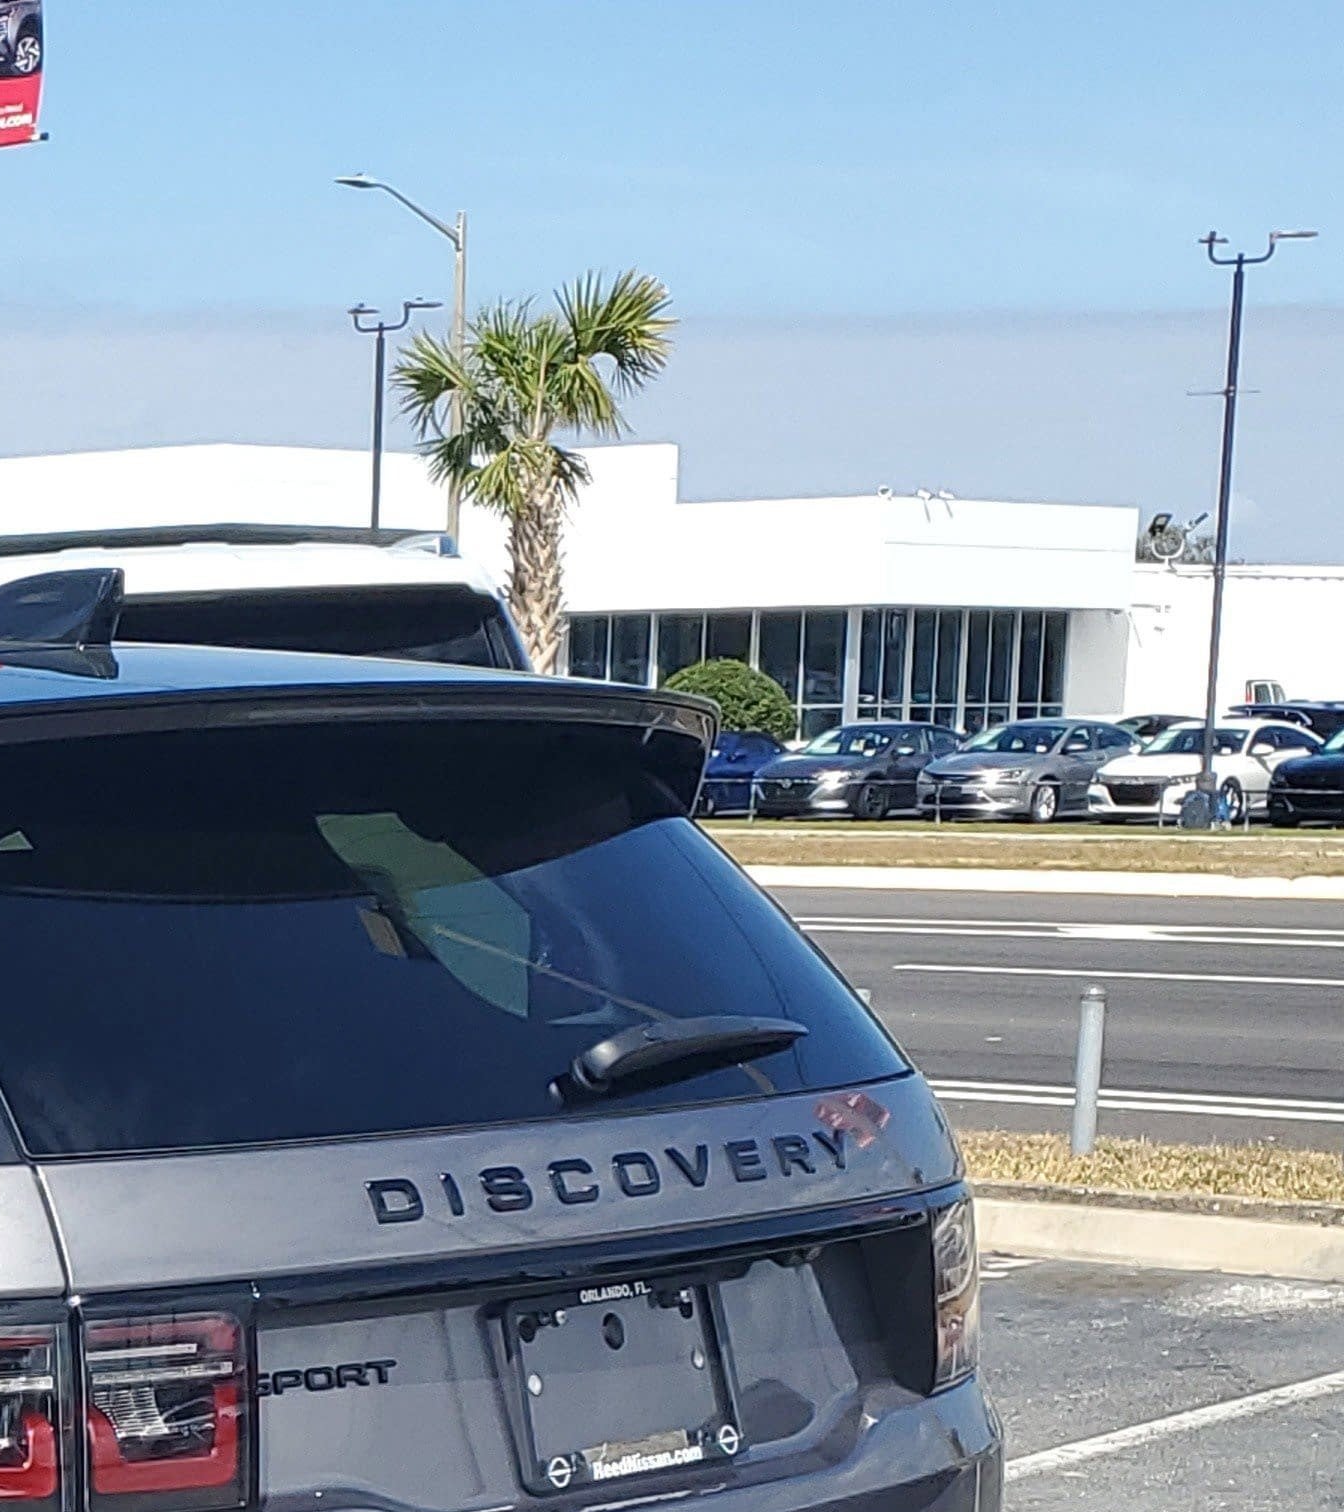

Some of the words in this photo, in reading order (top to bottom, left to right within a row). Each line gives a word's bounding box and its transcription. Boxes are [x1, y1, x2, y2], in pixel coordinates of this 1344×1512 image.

[365, 1130, 850, 1224] DISCOVERY
[579, 1283, 633, 1303] ORLANDO,
[257, 1358, 398, 1397] SPORT
[593, 1445, 703, 1480] ReedNissan.com
